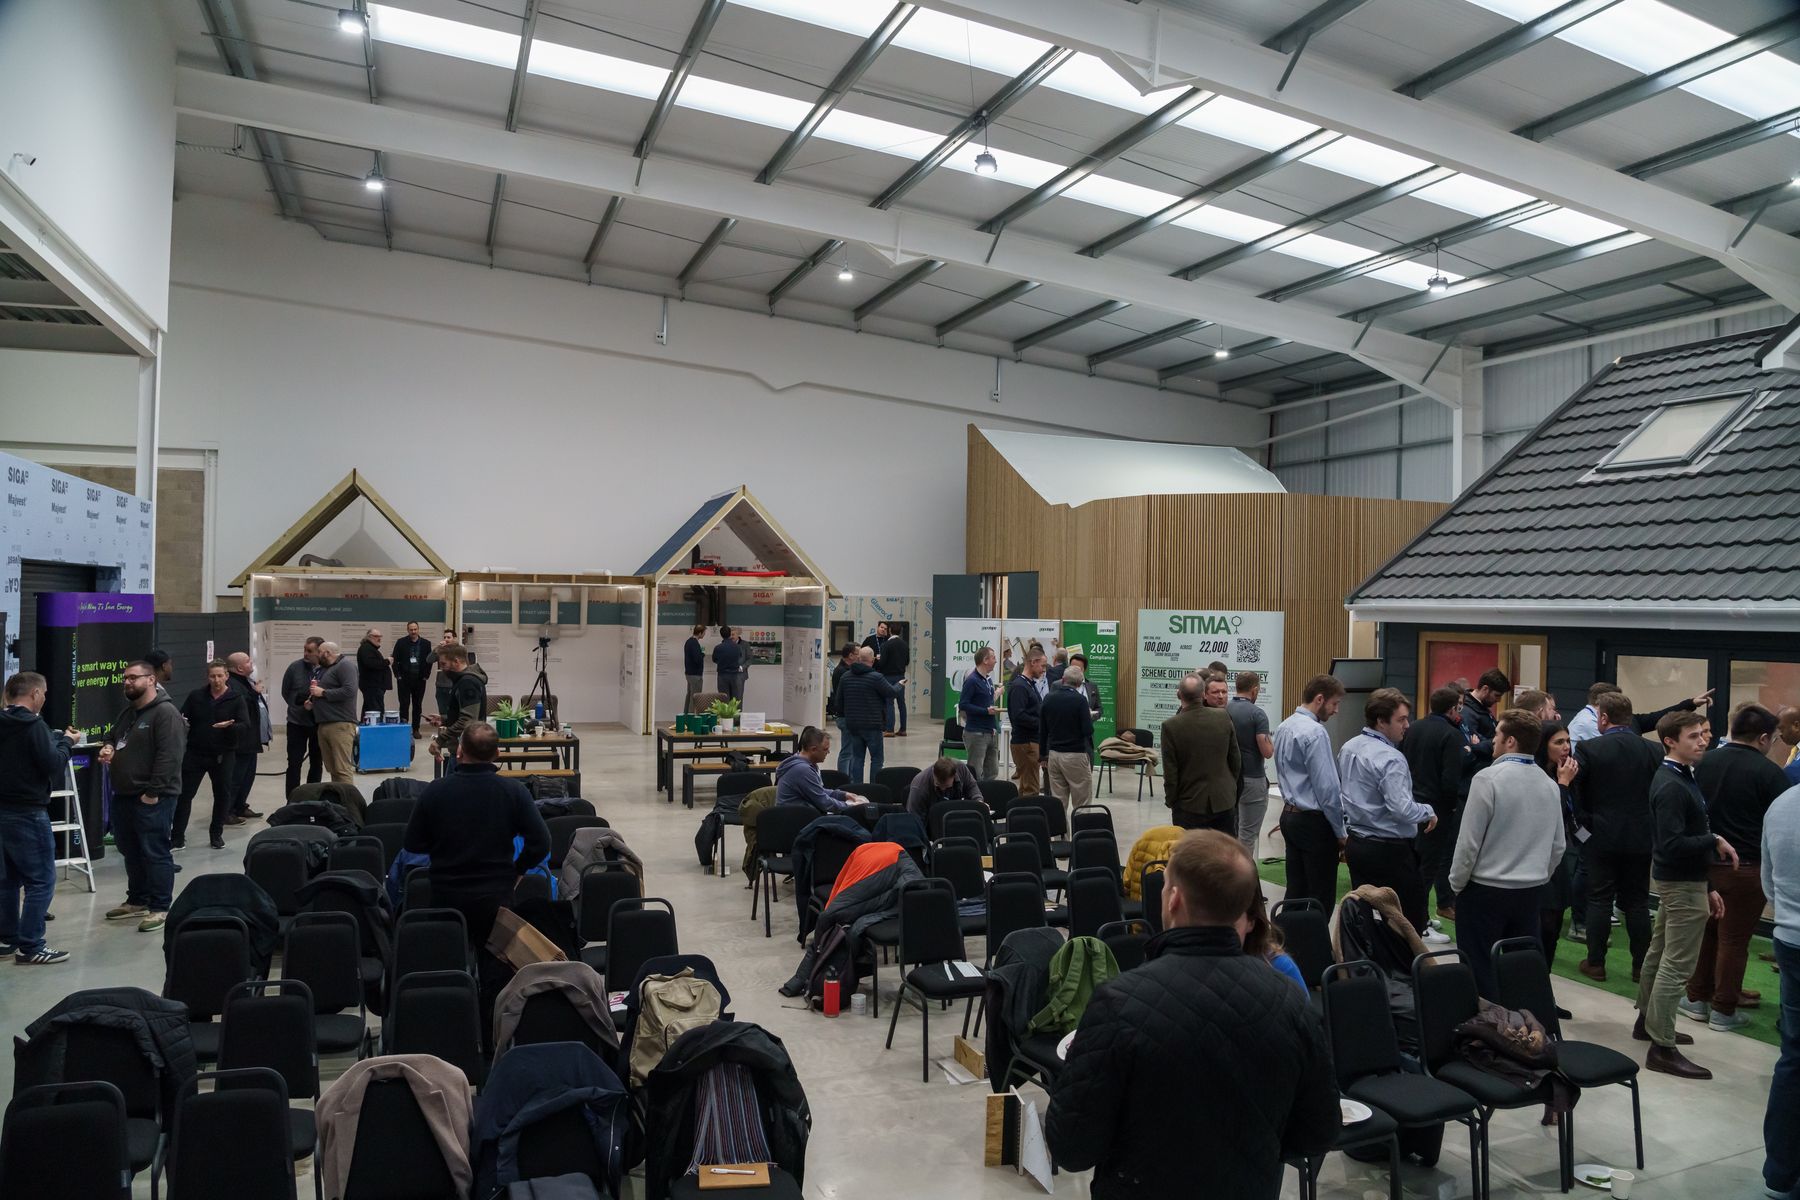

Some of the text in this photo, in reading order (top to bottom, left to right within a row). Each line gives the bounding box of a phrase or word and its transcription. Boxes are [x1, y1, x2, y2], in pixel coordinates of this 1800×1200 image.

[8, 466, 25, 485] SIGA
[52, 478, 65, 494] SIGA
[87, 488, 98, 502] SIGA
[1169, 615, 1231, 635] SITMA
[1090, 643, 1115, 653] 2023
[1144, 641, 1171, 653] 100,000
[1199, 641, 1229, 653] 22,000
[81, 661, 98, 672] smart
[99, 661, 117, 672] way
[119, 659, 128, 669] to
[1141, 669, 1166, 678] SCHEME
[86, 677, 109, 687] energy
